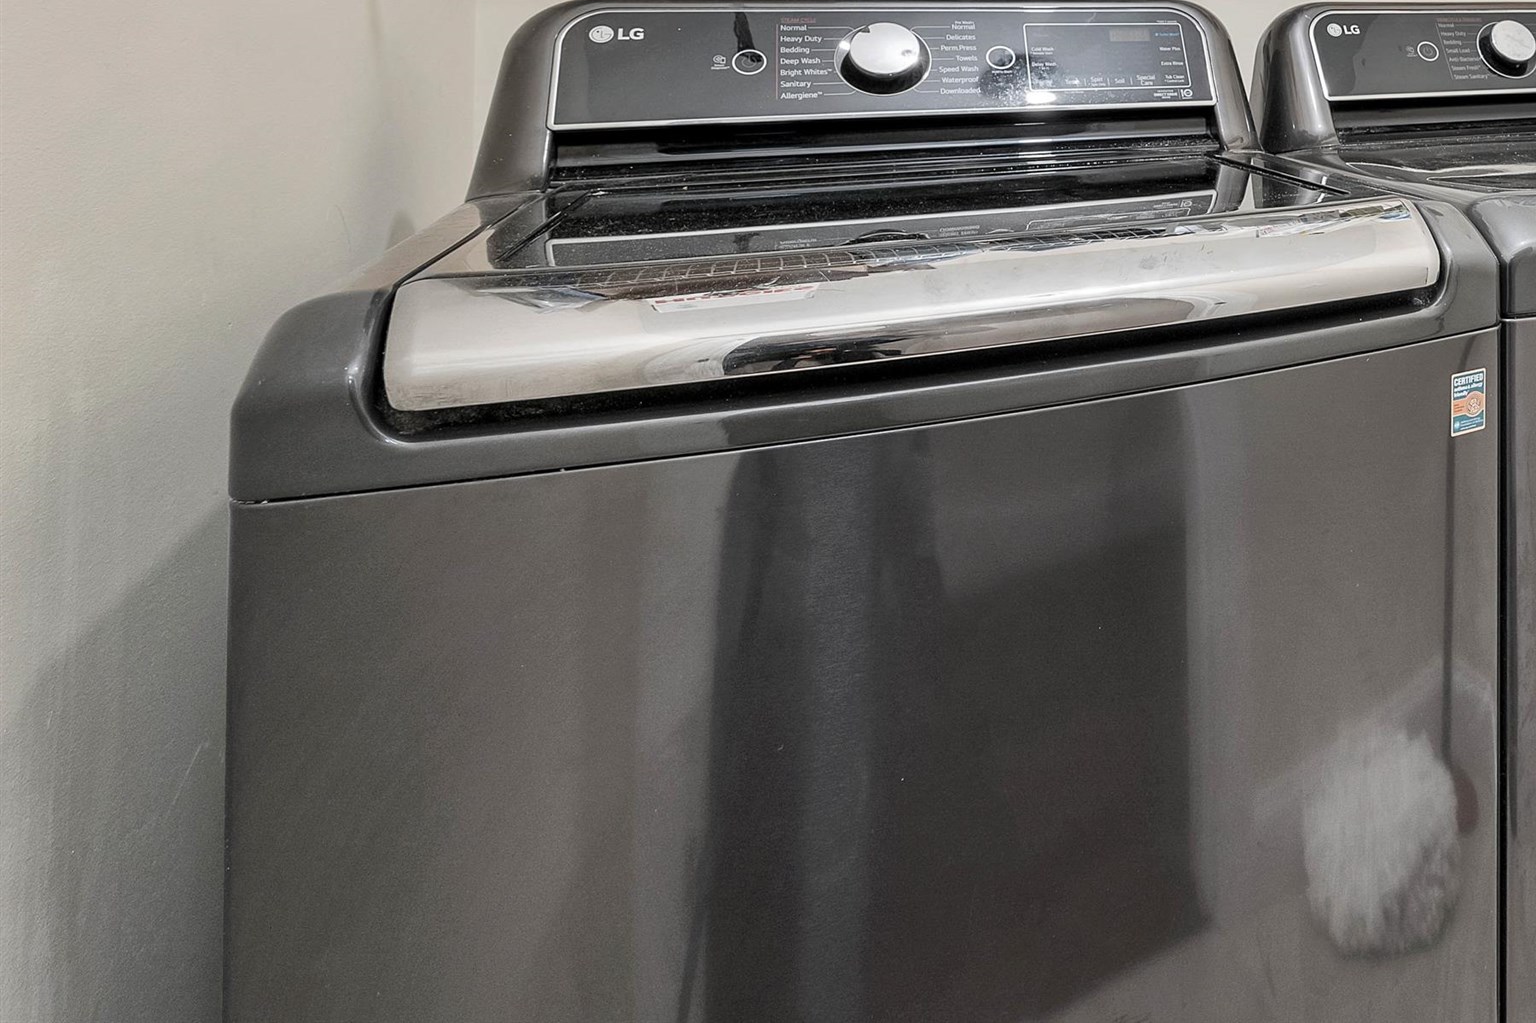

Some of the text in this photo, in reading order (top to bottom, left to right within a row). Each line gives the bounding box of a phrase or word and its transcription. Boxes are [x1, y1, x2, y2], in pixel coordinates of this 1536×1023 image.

[1343, 24, 1361, 35] LG
[617, 27, 645, 41] LG
[780, 69, 802, 77] Bright
[939, 66, 959, 74] Speed
[941, 76, 979, 84] Waterproof
[940, 87, 981, 95] Downloaded
[1454, 373, 1484, 387] CERTIFIED
